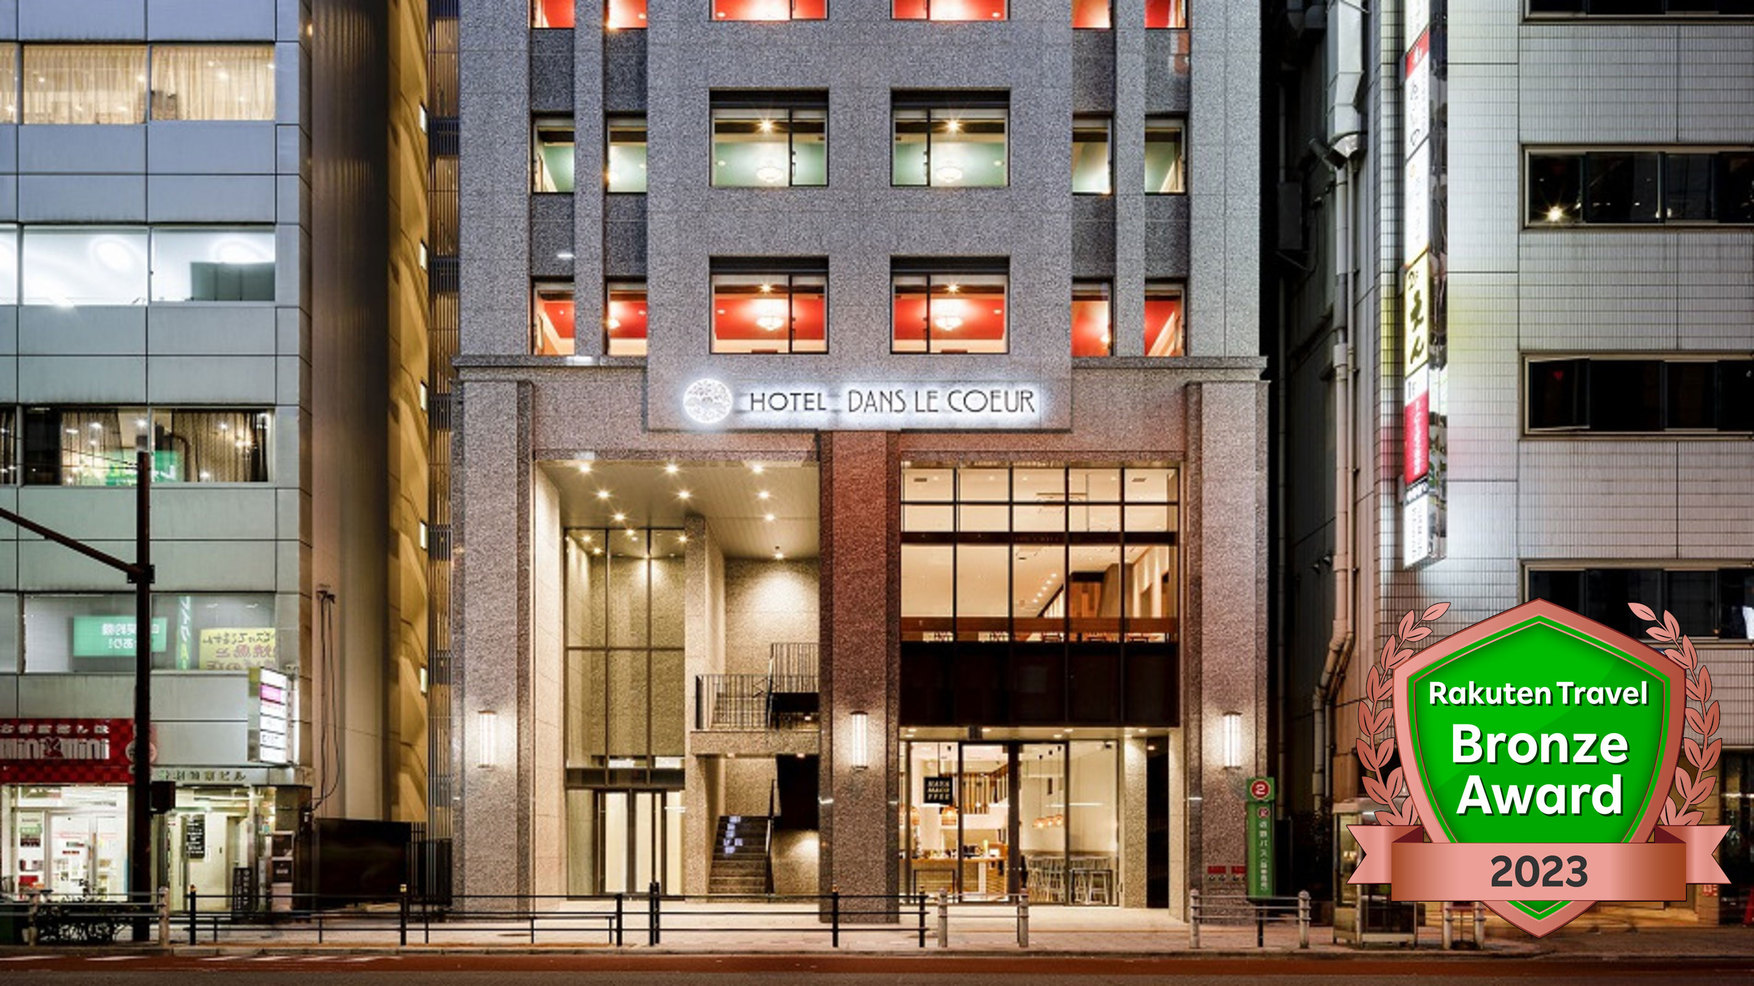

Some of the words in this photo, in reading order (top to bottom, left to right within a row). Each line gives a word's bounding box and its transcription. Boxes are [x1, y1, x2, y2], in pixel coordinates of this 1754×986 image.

[750, 392, 827, 412] HOTEL
[848, 390, 906, 413] DANS
[915, 391, 939, 413] LE
[947, 390, 1035, 413] COEUR
[61, 738, 110, 760] mini
[1255, 783, 1266, 795] 2
